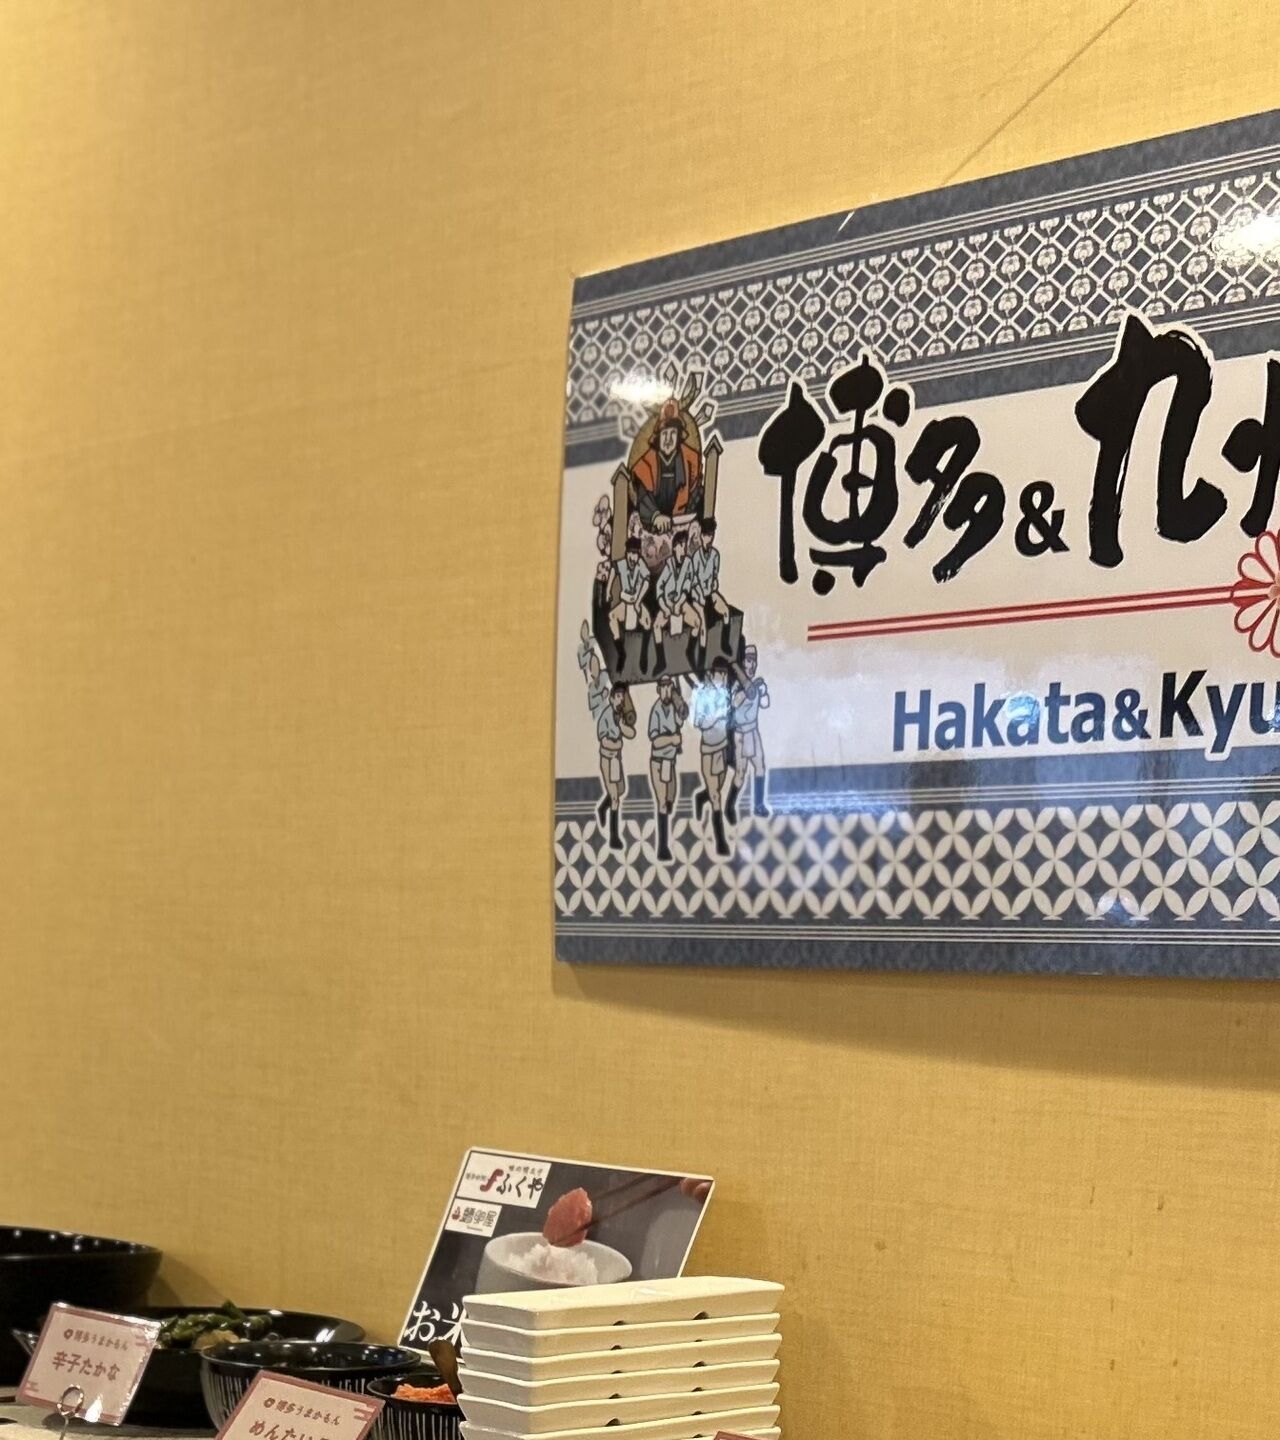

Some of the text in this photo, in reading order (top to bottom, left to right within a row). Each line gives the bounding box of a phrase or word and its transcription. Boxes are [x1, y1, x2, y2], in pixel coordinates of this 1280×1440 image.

[496, 1173, 544, 1200] ふくや
[52, 1351, 120, 1381] 辛子たかな
